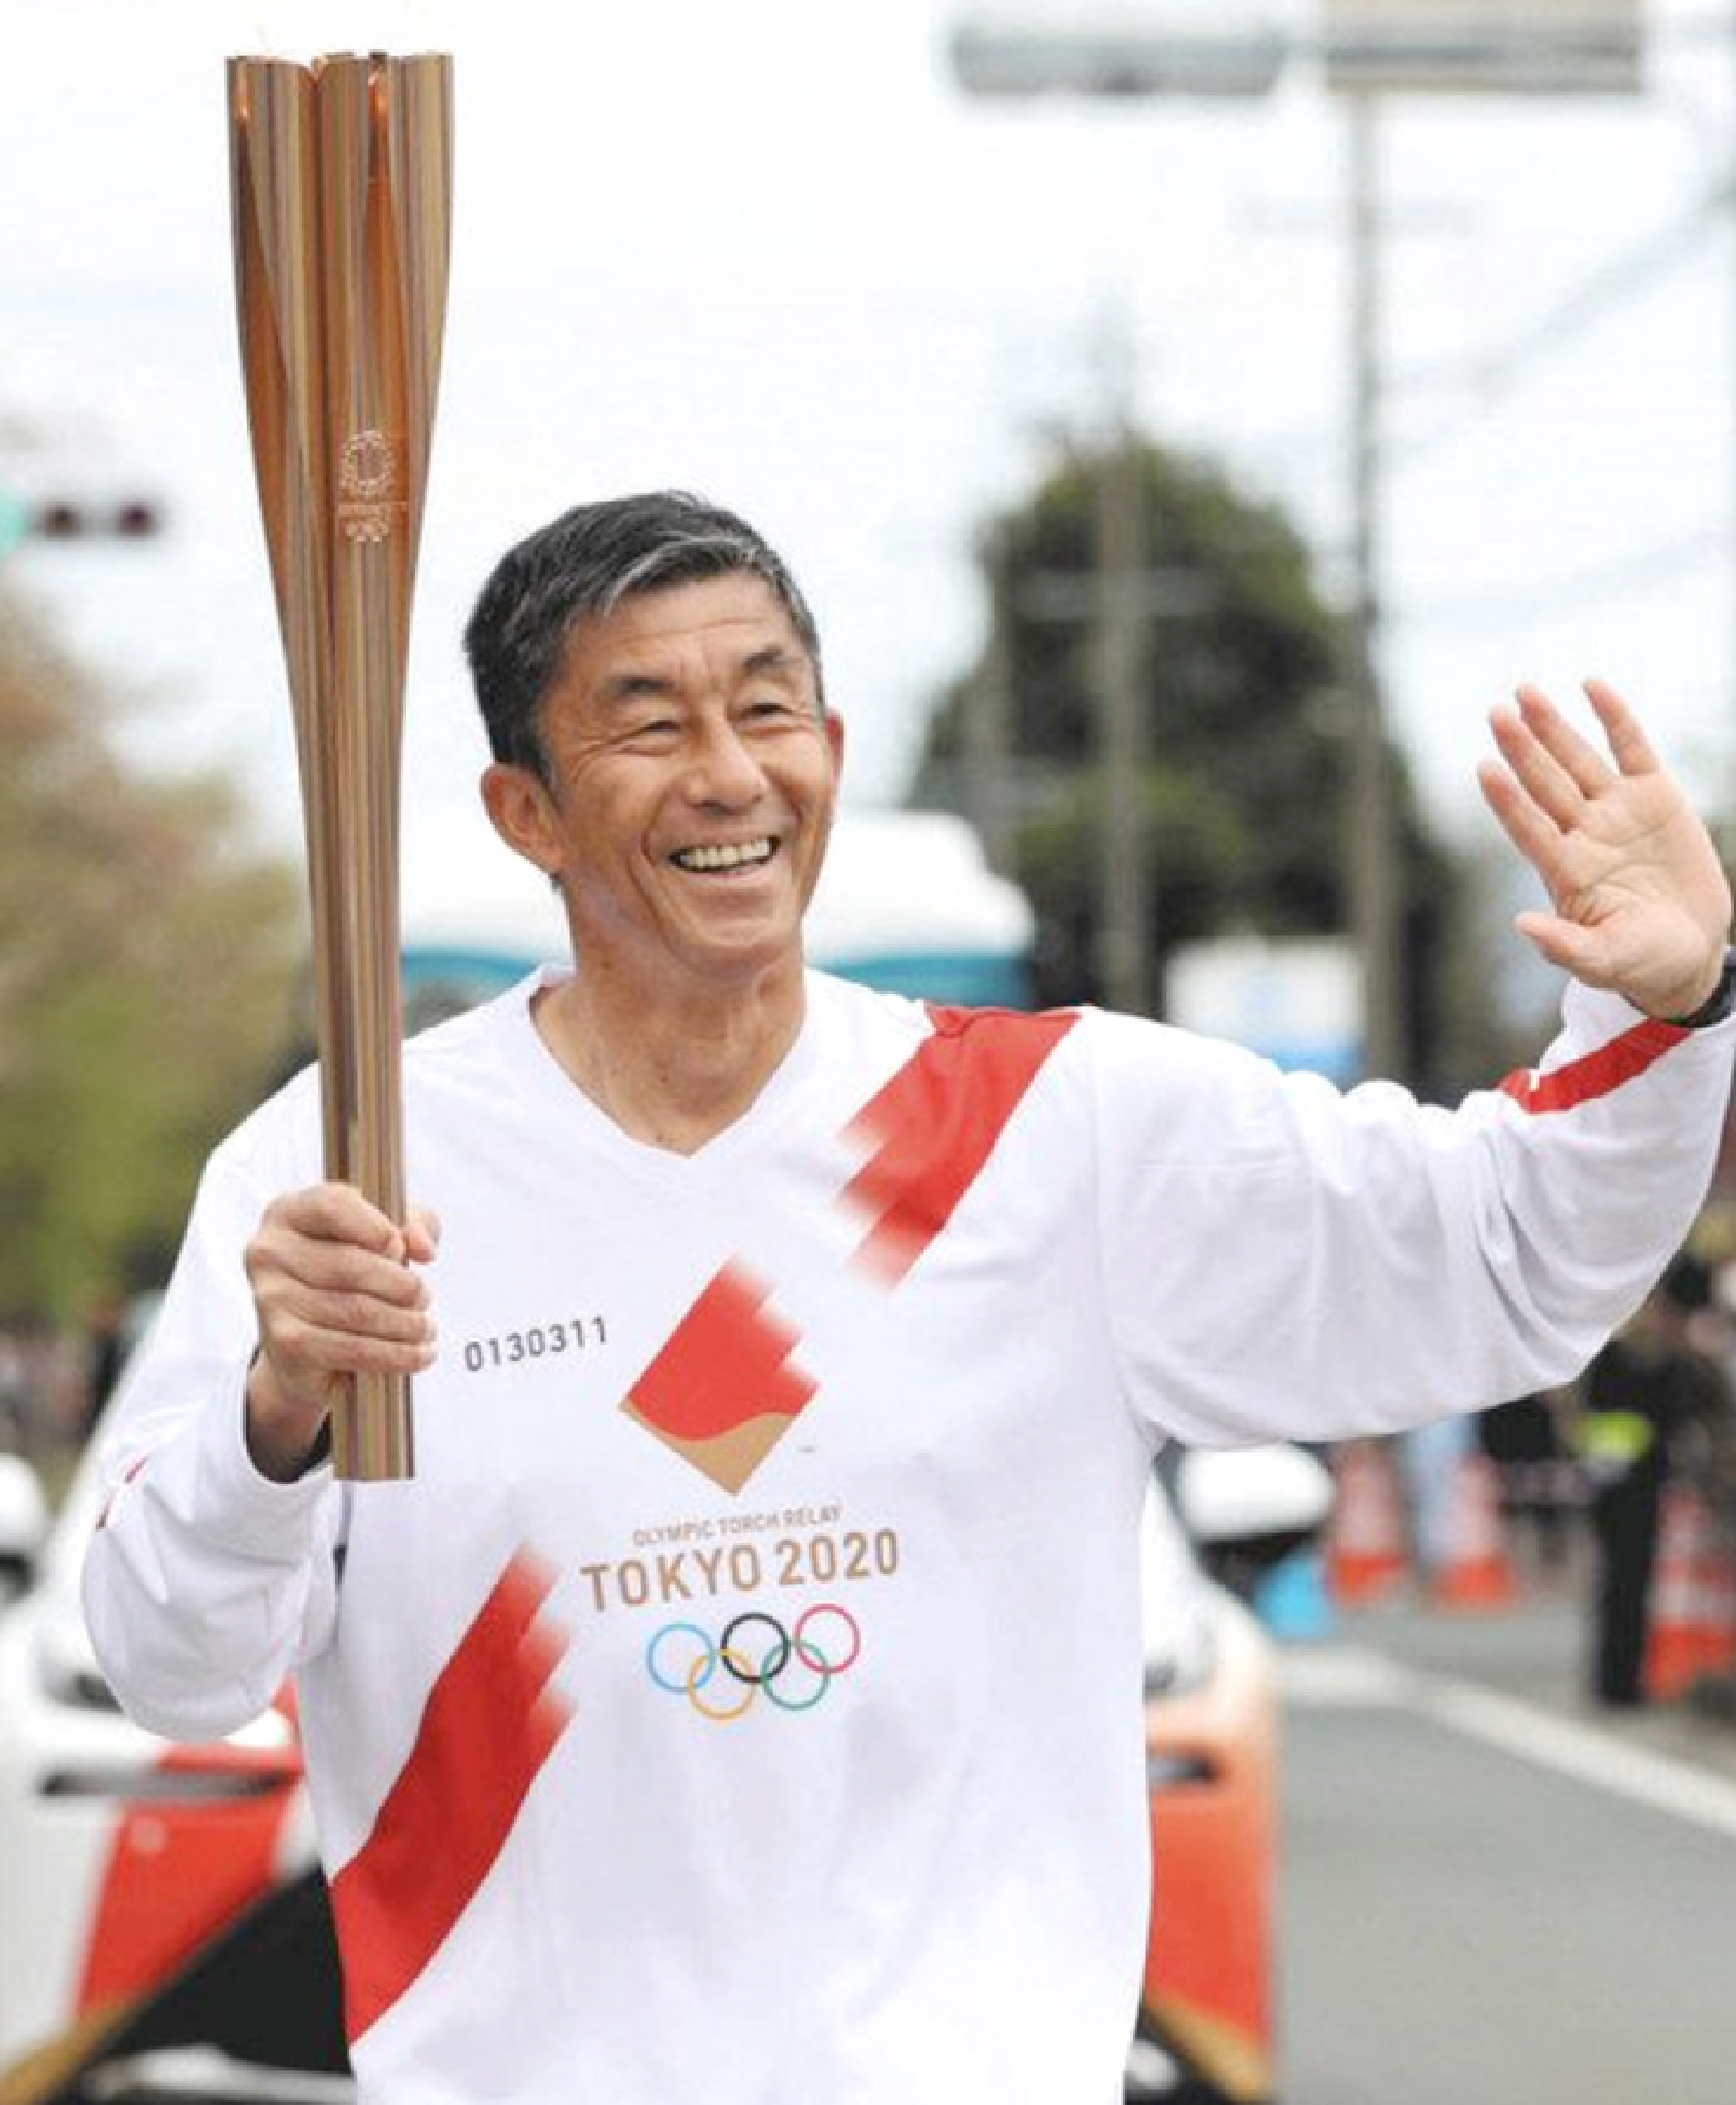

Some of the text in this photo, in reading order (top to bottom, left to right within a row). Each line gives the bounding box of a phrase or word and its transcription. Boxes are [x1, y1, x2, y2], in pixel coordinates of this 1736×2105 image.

[465, 1315, 607, 1371] 0130311
[633, 1503, 842, 1547] OLYMPIC TORCH RELAY
[580, 1528, 898, 1612] TOKYO 2020
